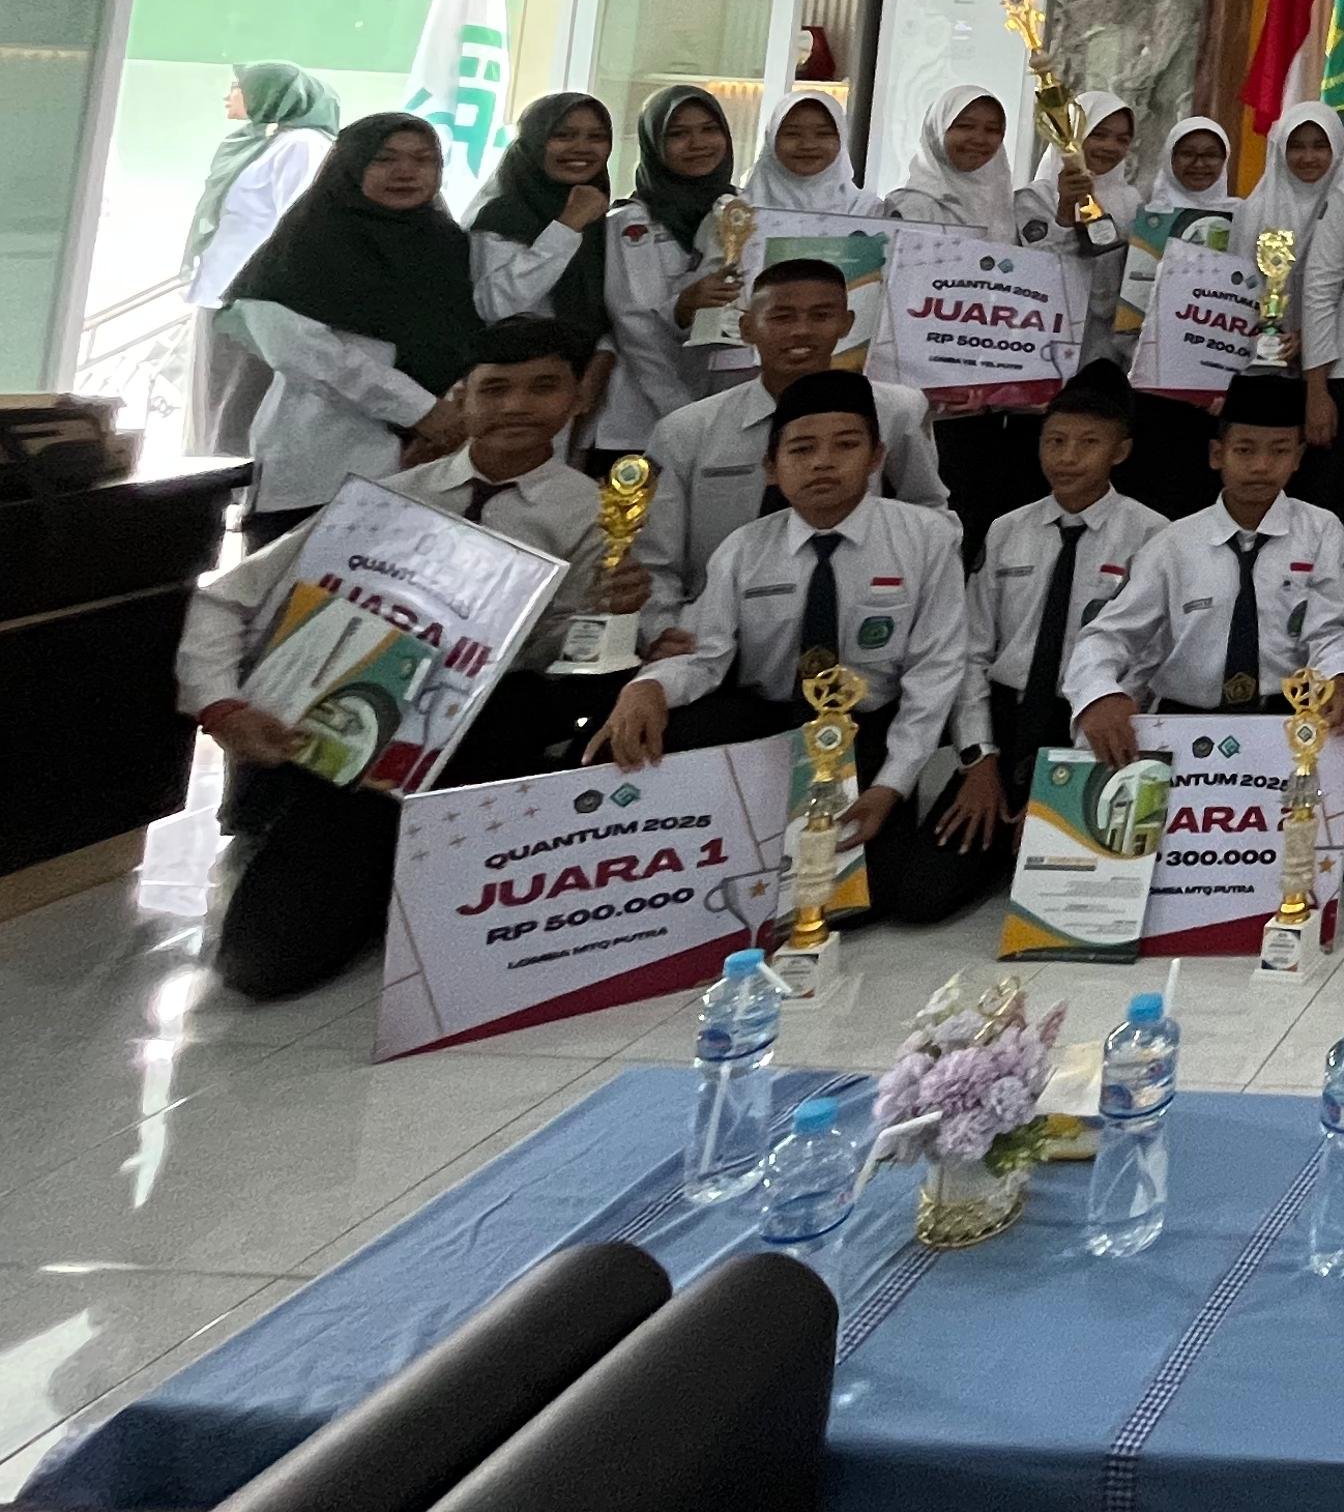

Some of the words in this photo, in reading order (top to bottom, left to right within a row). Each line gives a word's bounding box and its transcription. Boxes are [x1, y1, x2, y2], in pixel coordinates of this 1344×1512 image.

[906, 296, 1047, 333] JUARA
[926, 331, 954, 345] RP
[957, 332, 1036, 354] 500.000
[444, 635, 493, 679] III
[1166, 806, 1268, 835] ARA
[485, 821, 639, 870] QUANTUM
[642, 814, 712, 833] 2025
[1166, 849, 1277, 866] 300.000
[455, 847, 685, 916] JUARA
[696, 837, 729, 869] 1
[486, 920, 539, 946] RP
[543, 887, 696, 933] 500.000
